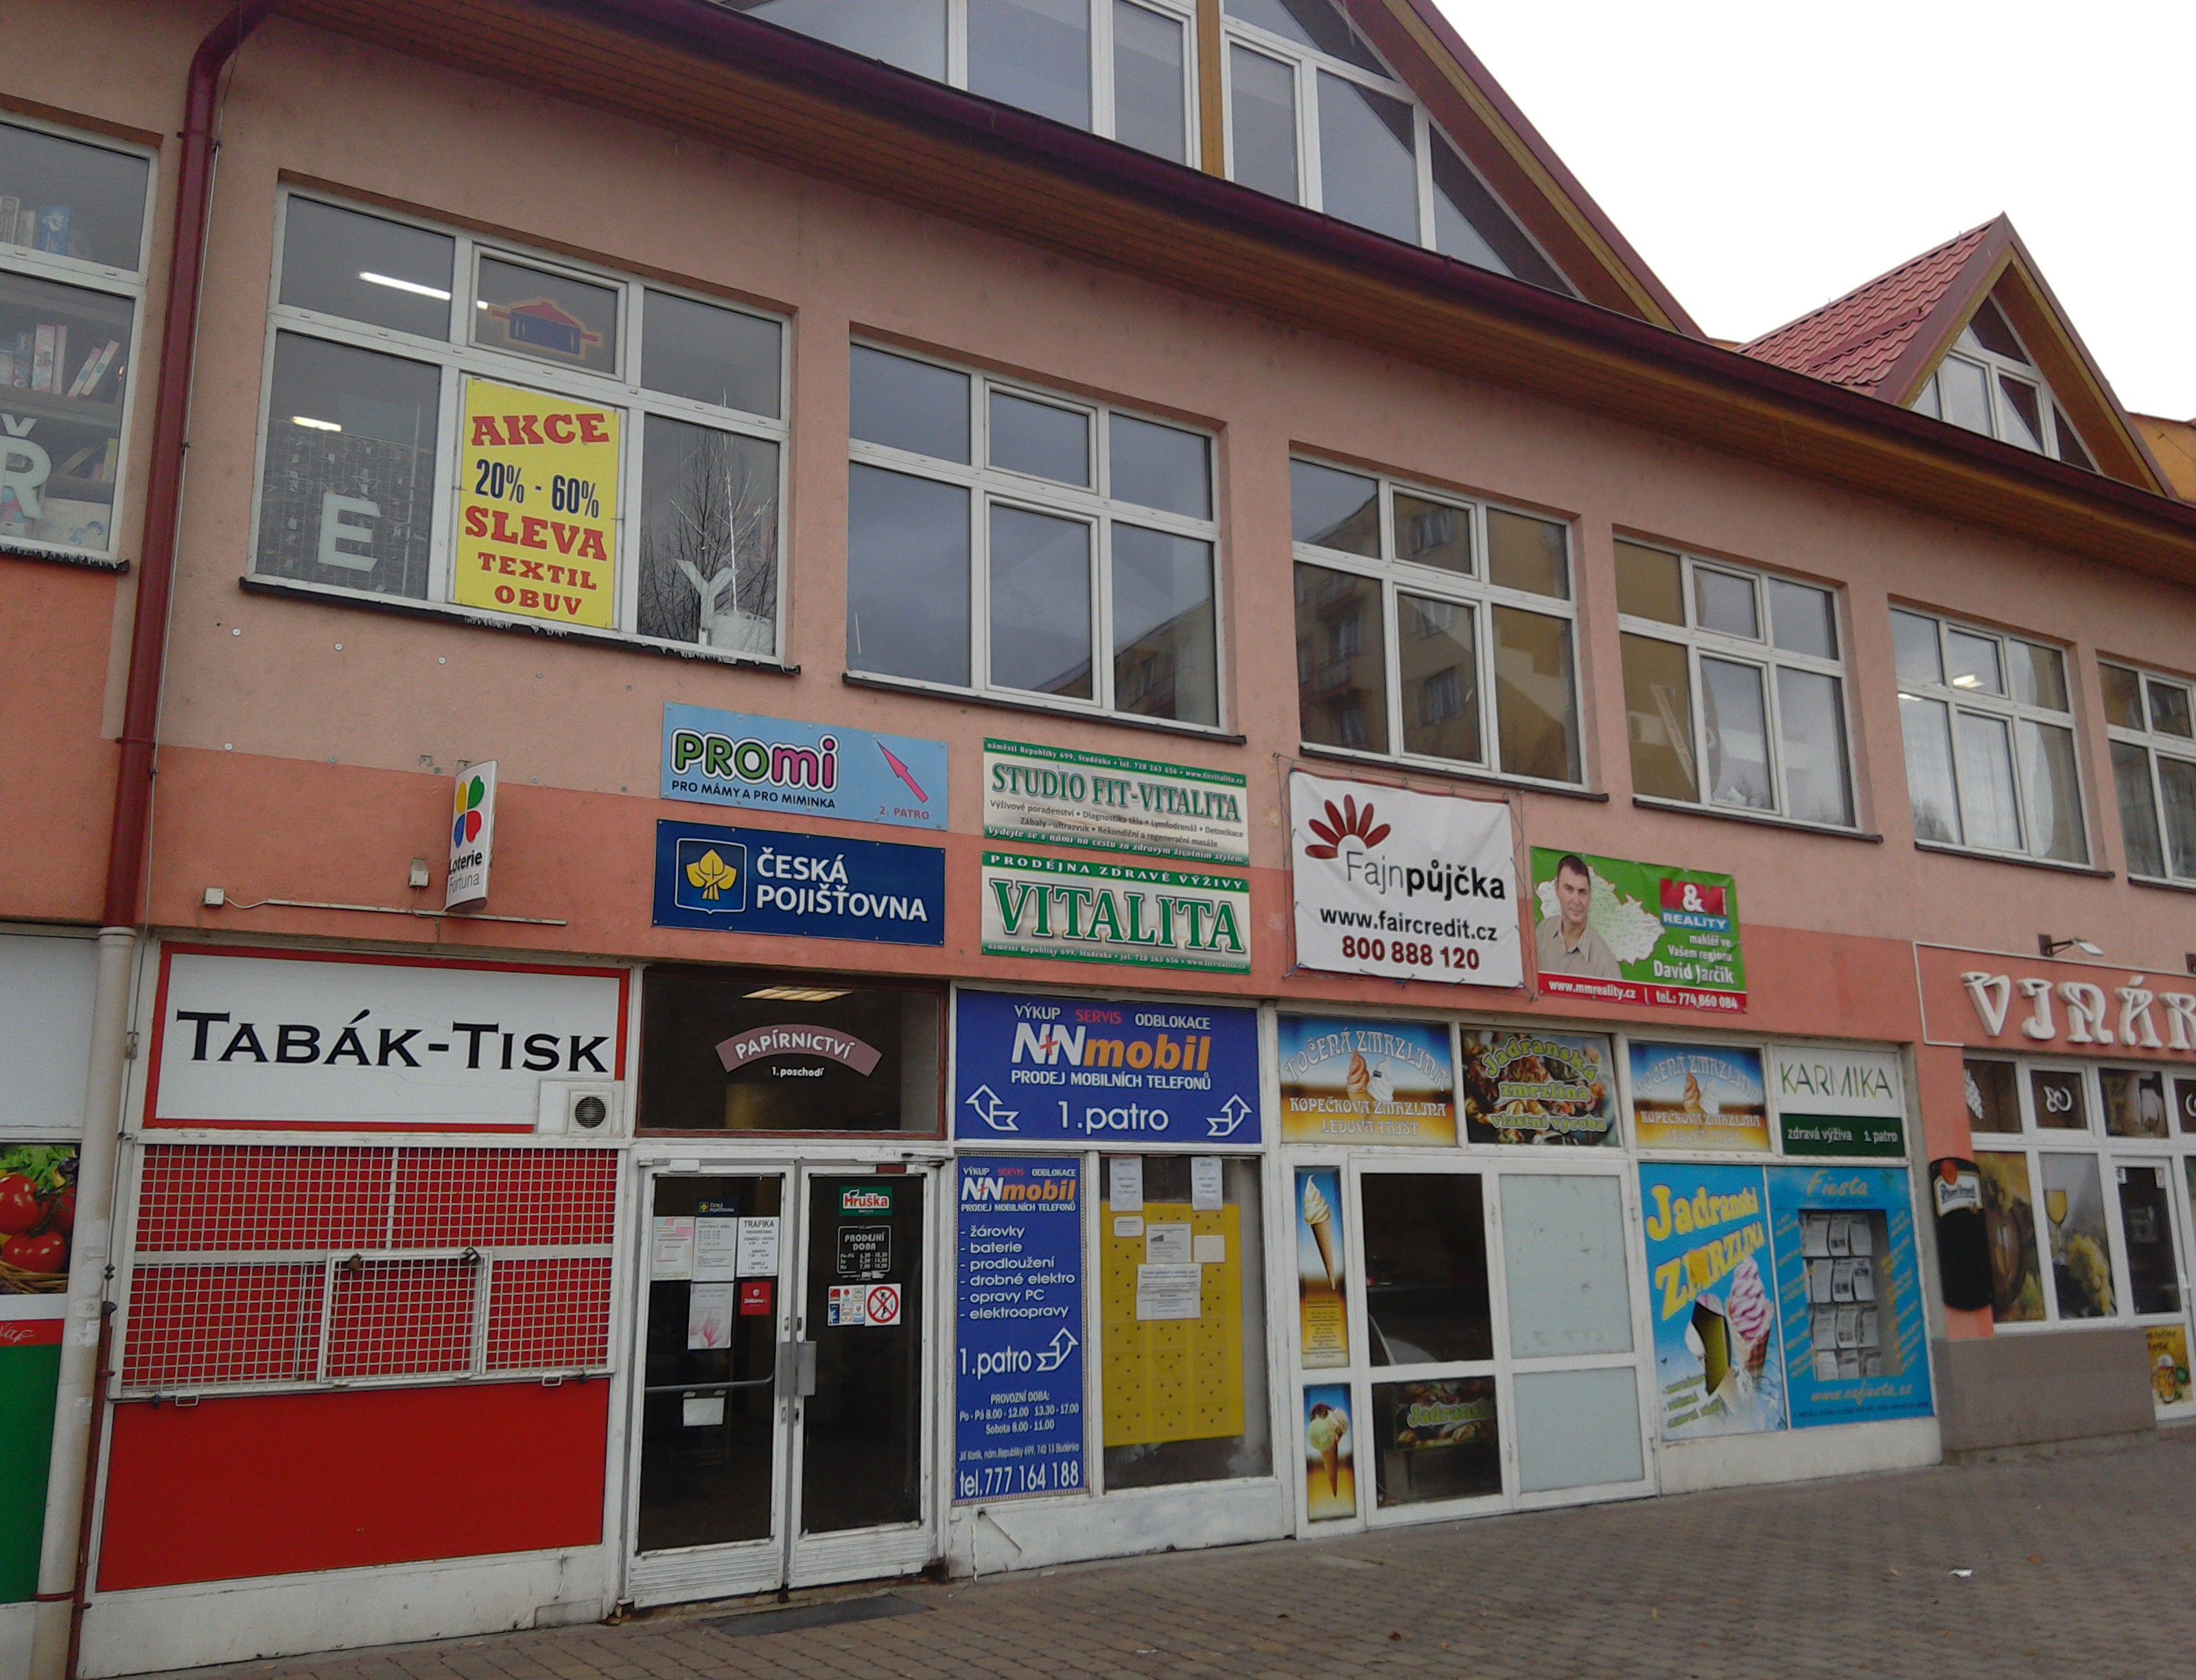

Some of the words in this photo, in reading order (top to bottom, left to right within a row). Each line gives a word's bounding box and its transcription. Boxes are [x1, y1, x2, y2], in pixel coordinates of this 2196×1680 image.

[471, 412, 610, 447] AKCE
[475, 458, 525, 506] 20%
[551, 474, 600, 520] 60%
[316, 491, 382, 573] E
[465, 505, 608, 562] SLEVA
[477, 551, 598, 592] TEXTIL
[494, 584, 584, 616] OBUV
[1020, 746, 1057, 760] Republiky
[671, 780, 698, 793] PRO
[701, 782, 741, 799] MÁMY
[742, 789, 751, 800] A
[753, 790, 778, 803] PRO
[781, 793, 836, 809] MIMINKA
[992, 762, 1087, 802] STUDIO
[1091, 775, 1241, 823] FIT-VITALITA
[893, 808, 930, 820] PATRO
[990, 799, 1026, 811] Výživové
[1027, 805, 1075, 817] poradenství
[1082, 810, 1127, 824] Diagnostika
[1205, 826, 1244, 838] Detoxikace
[1020, 817, 1047, 828] Zábaly
[1053, 821, 1090, 833] ultrazvuk
[1191, 839, 1218, 848] masáže
[1027, 832, 1038, 840] se
[1040, 833, 1047, 841] s
[1049, 834, 1074, 844] námi
[1077, 837, 1089, 845] na
[1092, 837, 1117, 849] cestu
[1132, 843, 1171, 855] zdravým
[449, 850, 483, 875] Loterie
[756, 846, 849, 885] ČESKÁ
[990, 854, 1091, 875] PRODEJNA
[1099, 865, 1171, 883] ZDRAVÉ
[1178, 872, 1243, 891] VÝŽIVY
[448, 872, 480, 894] Fortuna
[1346, 850, 1507, 902] Fajnpůjčka
[756, 883, 928, 923] POJIŠŤOVNA
[988, 877, 1246, 955] VITALITA
[1319, 907, 1499, 942] www.faircredit.cz
[1662, 912, 1727, 930] REALITY
[1689, 934, 1720, 946] makléř
[1342, 934, 1386, 961] 800
[1390, 940, 1434, 967] 888
[1440, 945, 1480, 971] 120
[1667, 944, 1698, 959] Vašem
[1698, 950, 1733, 963] regionu
[1652, 959, 1694, 981] David
[1548, 980, 1637, 1001] www.mmreality.cz
[1678, 992, 1697, 1007] 774
[1698, 994, 1717, 1007] 860
[1014, 1003, 1062, 1022] VÝKUP
[1075, 1009, 1123, 1025] SERVIS
[1134, 1012, 1211, 1030] ODBLOKACE
[176, 1009, 611, 1073] TABÁK-TISK
[734, 1028, 857, 1061] PAPÍRNICTVÍ
[1284, 1027, 1352, 1084] TOČENÁ
[1355, 1030, 1448, 1092] ZMRZLINA
[780, 1066, 824, 1079] poschodí
[1010, 1069, 1066, 1086] PRODEJ
[1070, 1071, 1143, 1088] MOBILNÍCH
[1147, 1074, 1212, 1091] TELEFONŮ
[1779, 1062, 1893, 1099] KARMIKA
[1499, 1082, 1590, 1101] zmrzlina
[1787, 1125, 1821, 1141] zdravá
[1873, 1130, 1898, 1144] patro
[962, 1165, 990, 1176] VÝKUP
[1031, 1168, 1077, 1177] ODBLOKACE
[1807, 1169, 1869, 1197] Fiesta
[843, 1193, 889, 1207] Hruška
[961, 1204, 992, 1212] PRODEJ
[994, 1202, 1036, 1212] MOBILNÍCH
[1038, 1201, 1076, 1212] TELEFONŮ
[743, 1220, 775, 1228] TRAFIKA
[970, 1224, 1025, 1239] žárovky
[844, 1231, 885, 1242] PRODEJNÍ
[852, 1242, 876, 1251] DOBA
[970, 1241, 1023, 1254] baterie
[970, 1255, 1055, 1272] prodloužení
[970, 1273, 1024, 1286] drobné
[1027, 1272, 1076, 1285] elektro
[970, 1291, 1022, 1305] opravy
[1025, 1289, 1046, 1301] PC
[970, 1306, 1069, 1320] elektroopravy
[990, 1390, 1027, 1405] PROVOZNÍ
[1028, 1390, 1051, 1403] DOBA:
[959, 1410, 970, 1423] Po
[974, 1408, 985, 1421] Pá
[985, 1408, 1003, 1421] 8.00
[1008, 1406, 1029, 1419] 12.00
[1034, 1404, 1055, 1416] 13.30
[1060, 1403, 1079, 1415] 17.00
[985, 1423, 1011, 1435] Sobota
[1012, 1421, 1029, 1433] 8.00
[1033, 1419, 1055, 1432] 11.00
[1018, 1462, 1047, 1492] 164
[1052, 1459, 1079, 1489] 188
